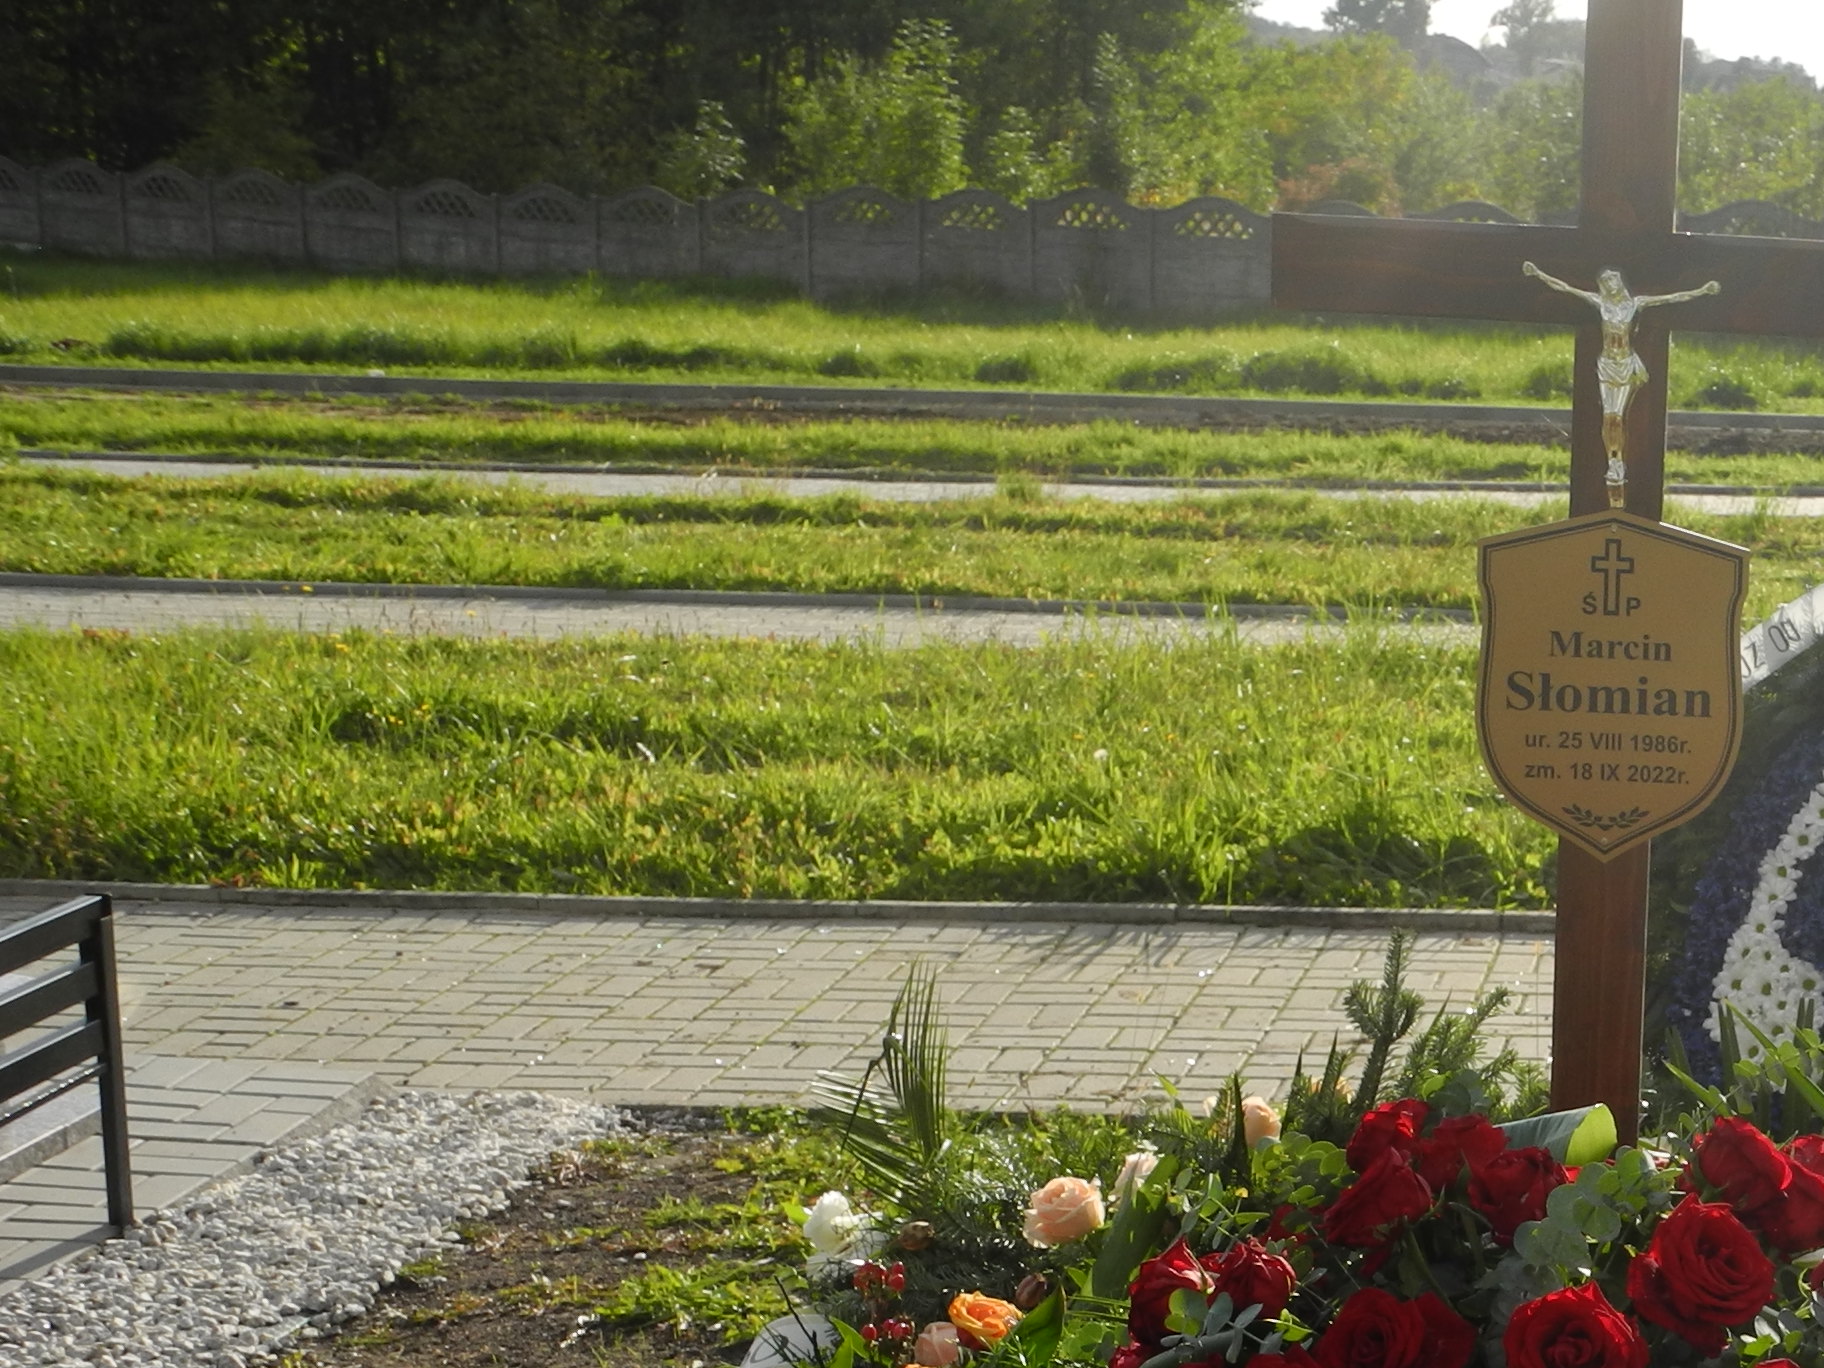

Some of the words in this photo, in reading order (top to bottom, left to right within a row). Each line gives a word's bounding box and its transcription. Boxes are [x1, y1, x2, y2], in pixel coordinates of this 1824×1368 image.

[1582, 591, 1598, 616] Ś
[1626, 596, 1641, 617] P
[1549, 629, 1673, 663] Marcin
[1505, 669, 1713, 719] Słomian
[1524, 733, 1551, 750] ur.
[1558, 731, 1583, 750] 25
[1590, 732, 1623, 751] VIII
[1630, 734, 1692, 755] 1986r.
[1524, 764, 1561, 780] zm.
[1570, 762, 1593, 781] 18
[1601, 764, 1620, 782] IX
[1626, 765, 1690, 785] 2022r.
